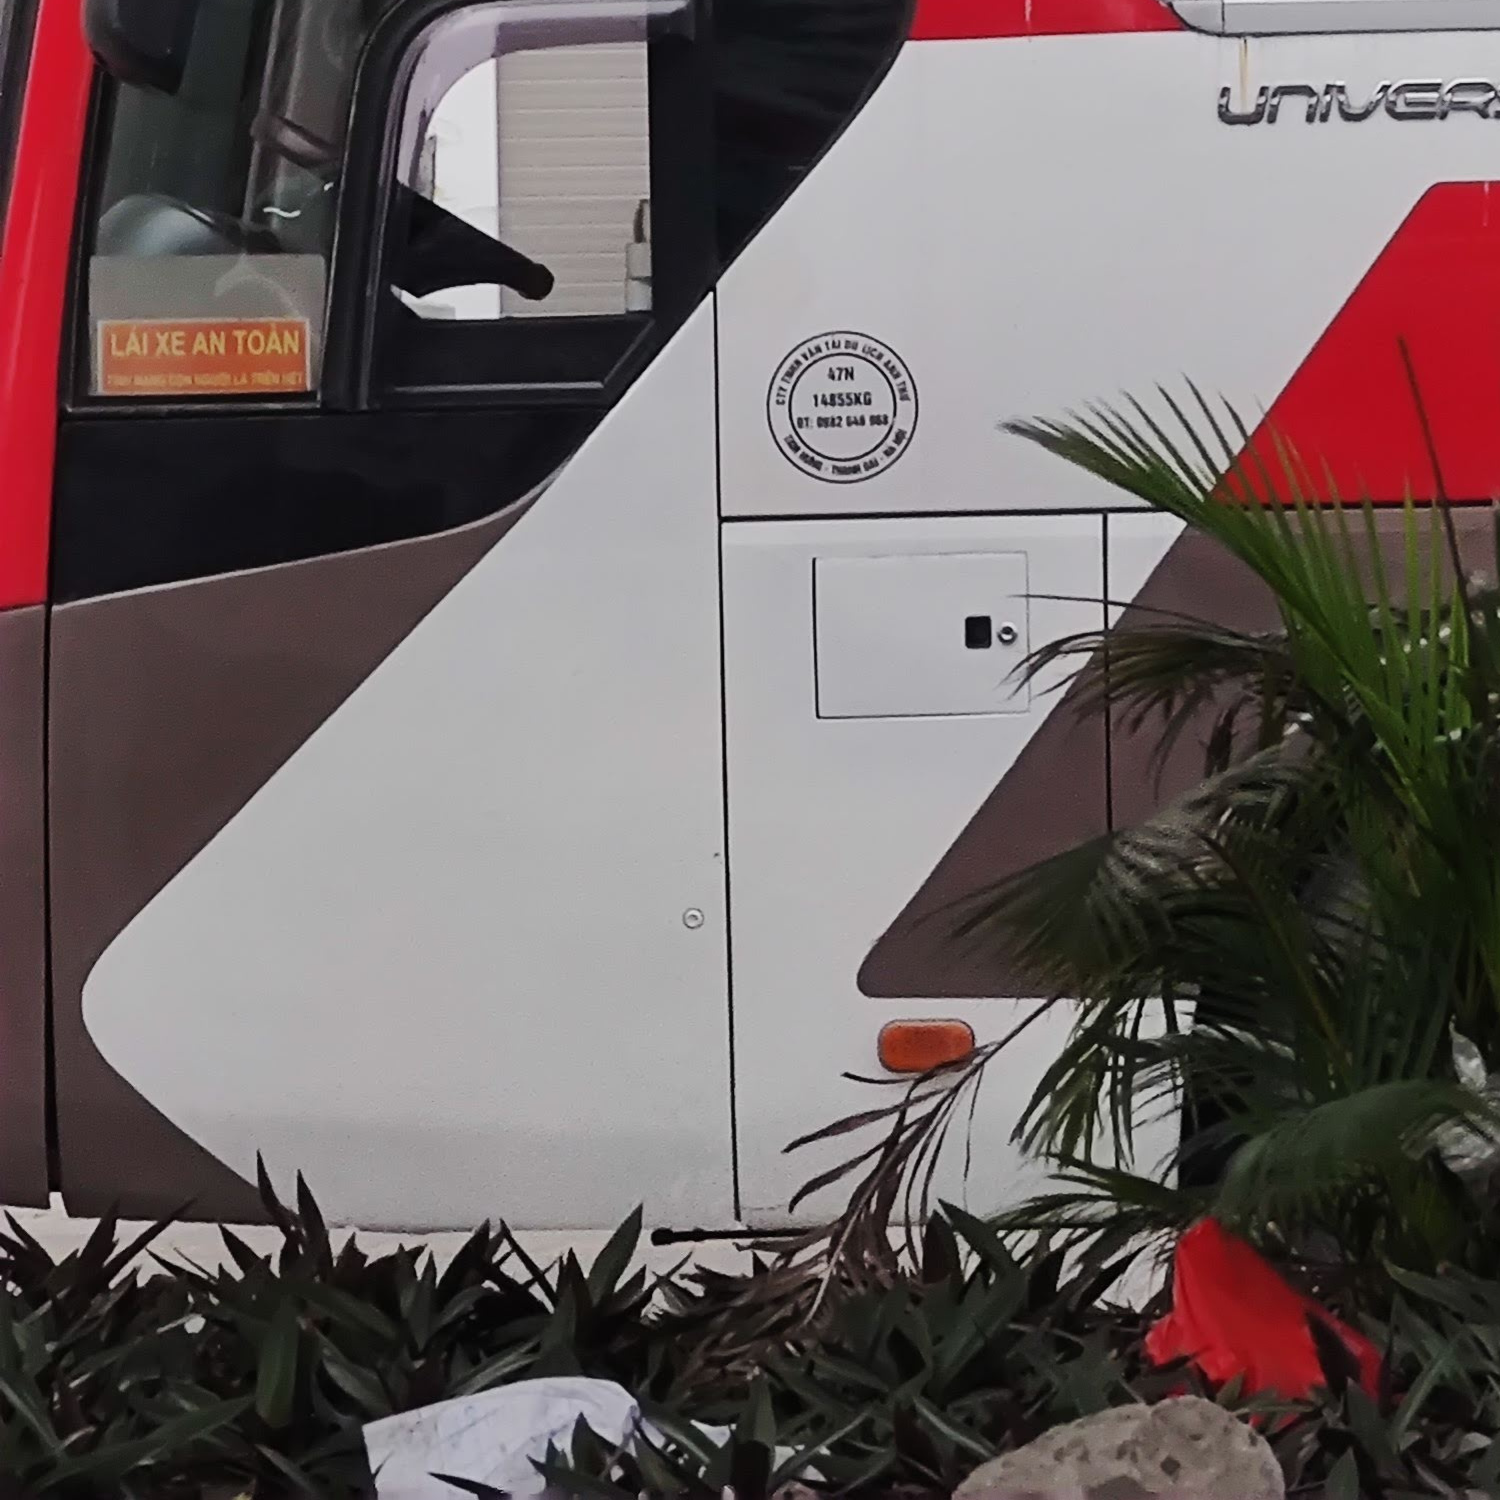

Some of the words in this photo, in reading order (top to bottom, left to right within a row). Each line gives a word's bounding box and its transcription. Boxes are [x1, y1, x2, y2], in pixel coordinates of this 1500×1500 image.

[110, 326, 148, 357] LÁI
[156, 331, 186, 357] XE
[192, 330, 226, 356] AN
[232, 323, 300, 356] TOÀN
[827, 366, 855, 382] 47N
